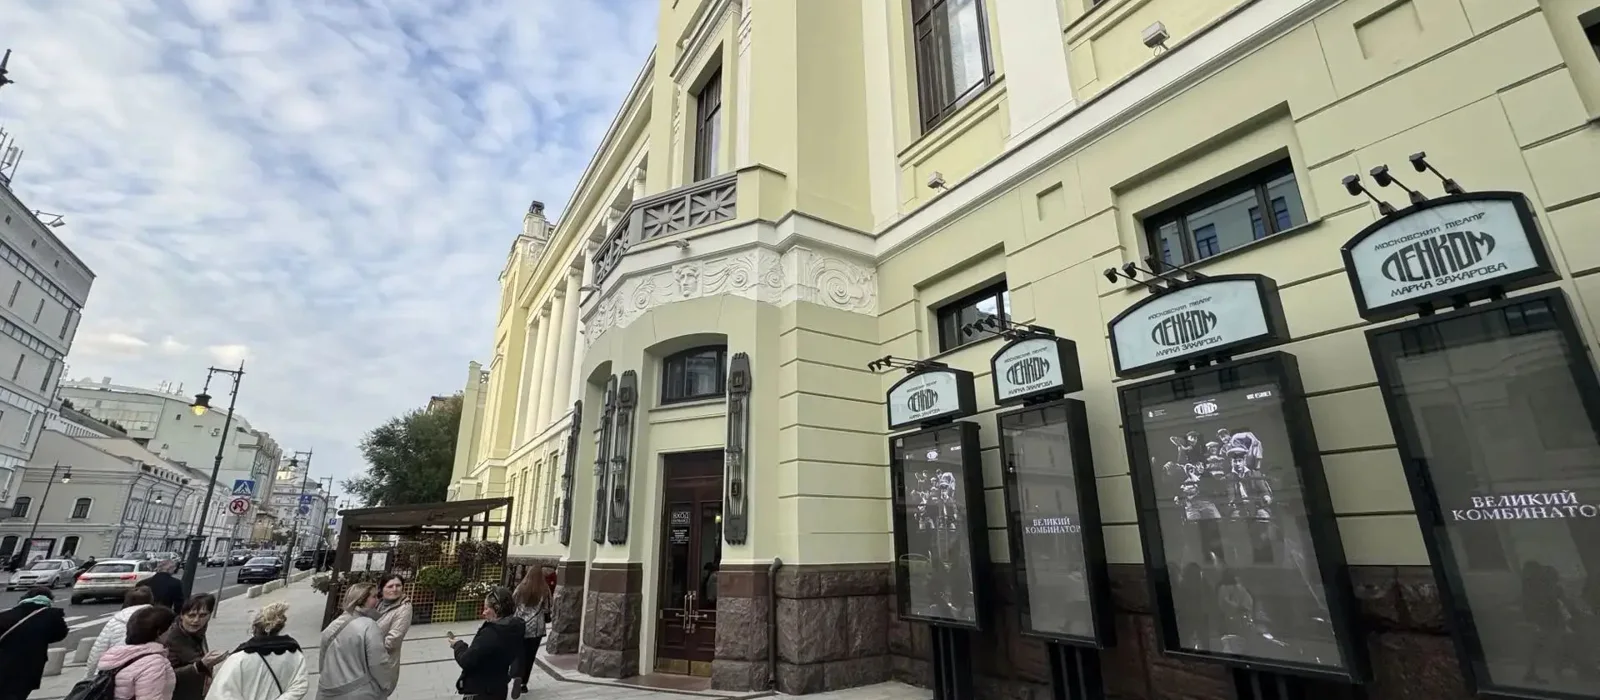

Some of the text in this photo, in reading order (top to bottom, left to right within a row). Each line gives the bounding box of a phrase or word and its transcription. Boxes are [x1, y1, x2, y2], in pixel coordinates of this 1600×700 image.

[1381, 231, 1496, 282] ЛЕНКОМ
[1391, 262, 1508, 297] МАРКА ЗАХАРОВА
[1151, 310, 1218, 346] ЛЕНКОМ
[1156, 335, 1223, 357] МАРКА ЗАХАРОВА
[1006, 357, 1050, 385] ЛЕНКОМ
[907, 389, 938, 412] ЛЕНКОМ
[1471, 490, 1578, 508] ВЕЛИКИЙ
[1033, 516, 1070, 526] ВЕЛИКИЙ
[1452, 504, 1600, 521] КОМБИНАТО
